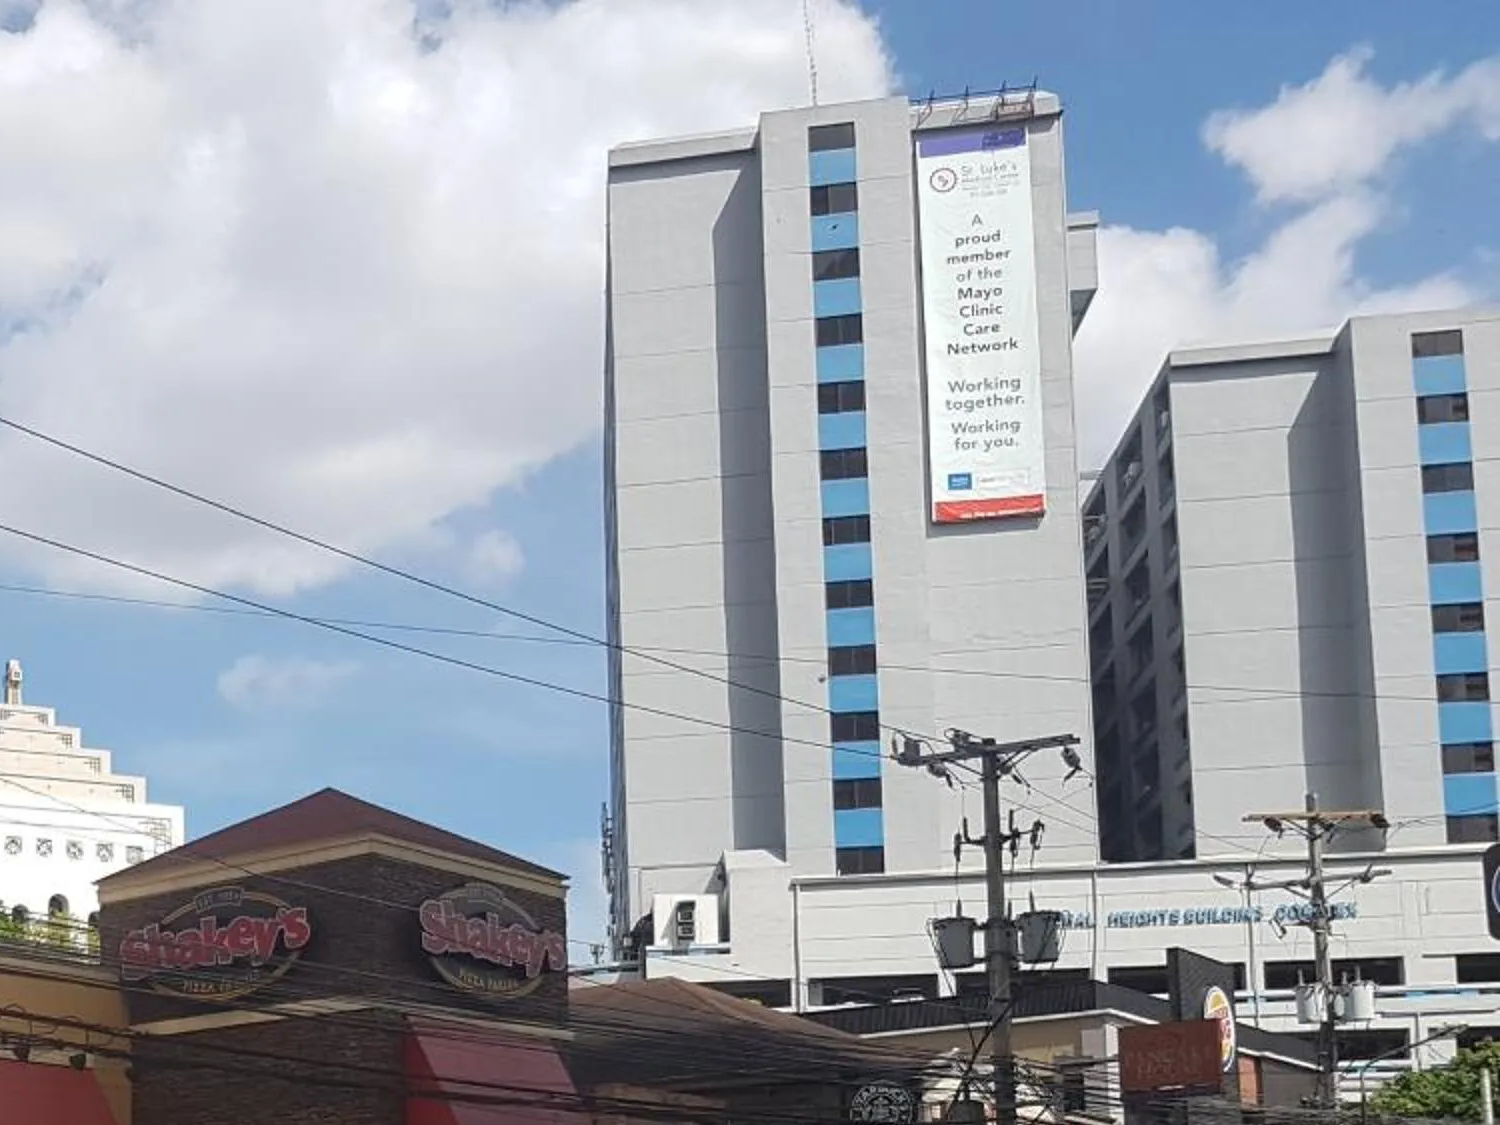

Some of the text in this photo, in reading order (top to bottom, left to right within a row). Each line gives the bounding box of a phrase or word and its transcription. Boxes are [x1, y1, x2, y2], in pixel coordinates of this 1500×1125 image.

[971, 213, 984, 227] A
[955, 230, 1001, 248] proud
[947, 249, 1011, 265] member
[956, 267, 1003, 283] of the
[957, 286, 1003, 302] Mayo
[959, 303, 1003, 318] Clinic
[963, 323, 1001, 336] Care
[947, 337, 1019, 356] Network
[948, 377, 1021, 393] Working
[946, 394, 1025, 413] together.
[951, 419, 1021, 435] Working
[955, 436, 1019, 452] for you.
[1106, 908, 1181, 928] HEIGHTS
[1275, 901, 1358, 921] COMLEX
[120, 906, 311, 981] Shakey's
